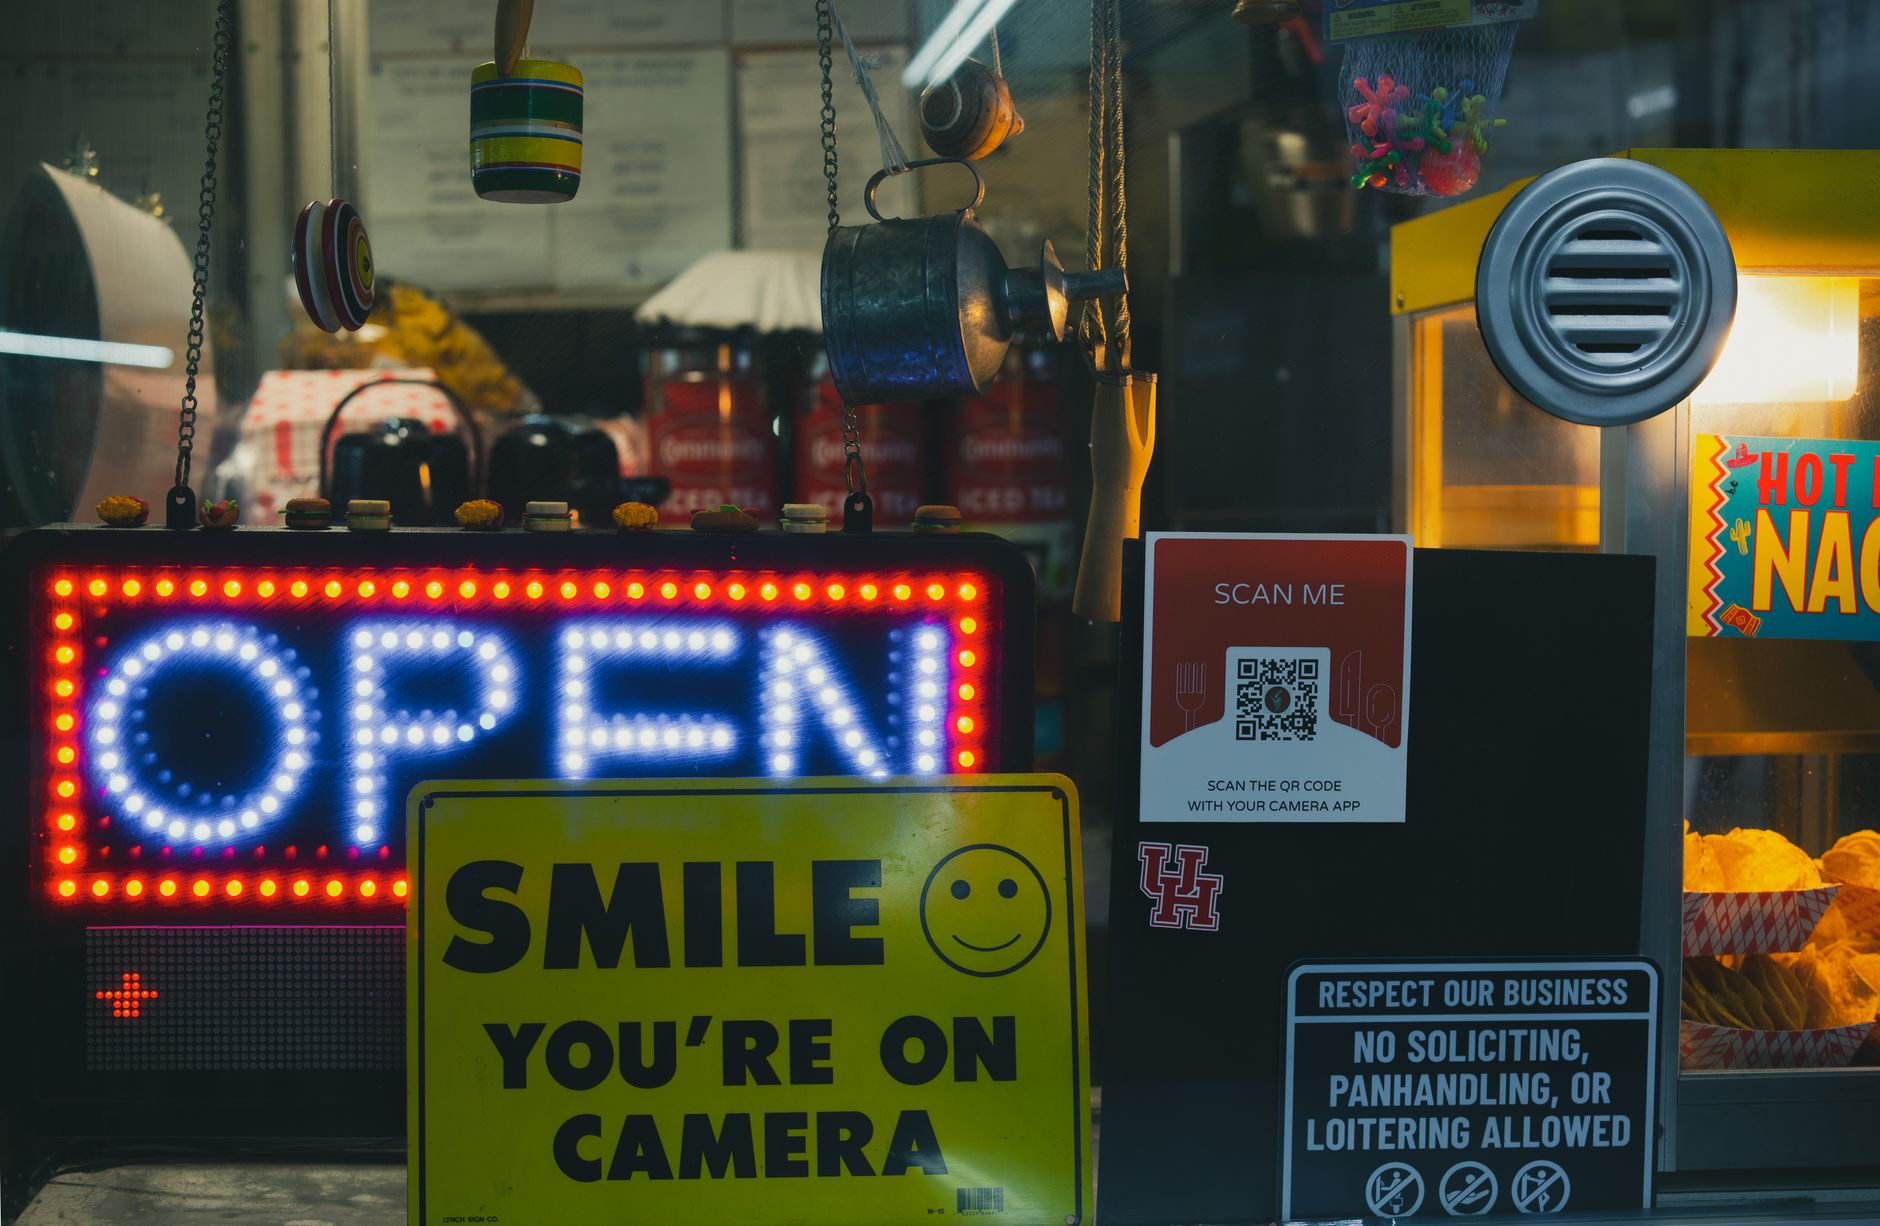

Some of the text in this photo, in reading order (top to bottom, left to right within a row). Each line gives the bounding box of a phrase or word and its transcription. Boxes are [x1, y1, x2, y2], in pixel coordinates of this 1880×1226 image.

[1757, 451, 1856, 507] HOT
[1214, 582, 1345, 605] SCAN ME
[86, 620, 954, 846] OPEN
[1207, 780, 1342, 793] SCAN THE QR CODE
[1187, 800, 1361, 812] WITH YOUR CAMERA APP
[441, 859, 885, 974] SMILE
[1319, 978, 1628, 1008] RESPECT OUR BUSINESS
[482, 1015, 1018, 1091] YOU'RE ON
[1353, 1028, 1590, 1065] NO SOLICITING,
[1329, 1071, 1612, 1109] PANHANDLING, OR
[552, 1109, 949, 1183] CAMERA
[1306, 1114, 1631, 1151] LOITERING ALLOWED
[443, 1215, 501, 1224] LYNCH SIGN CO.
